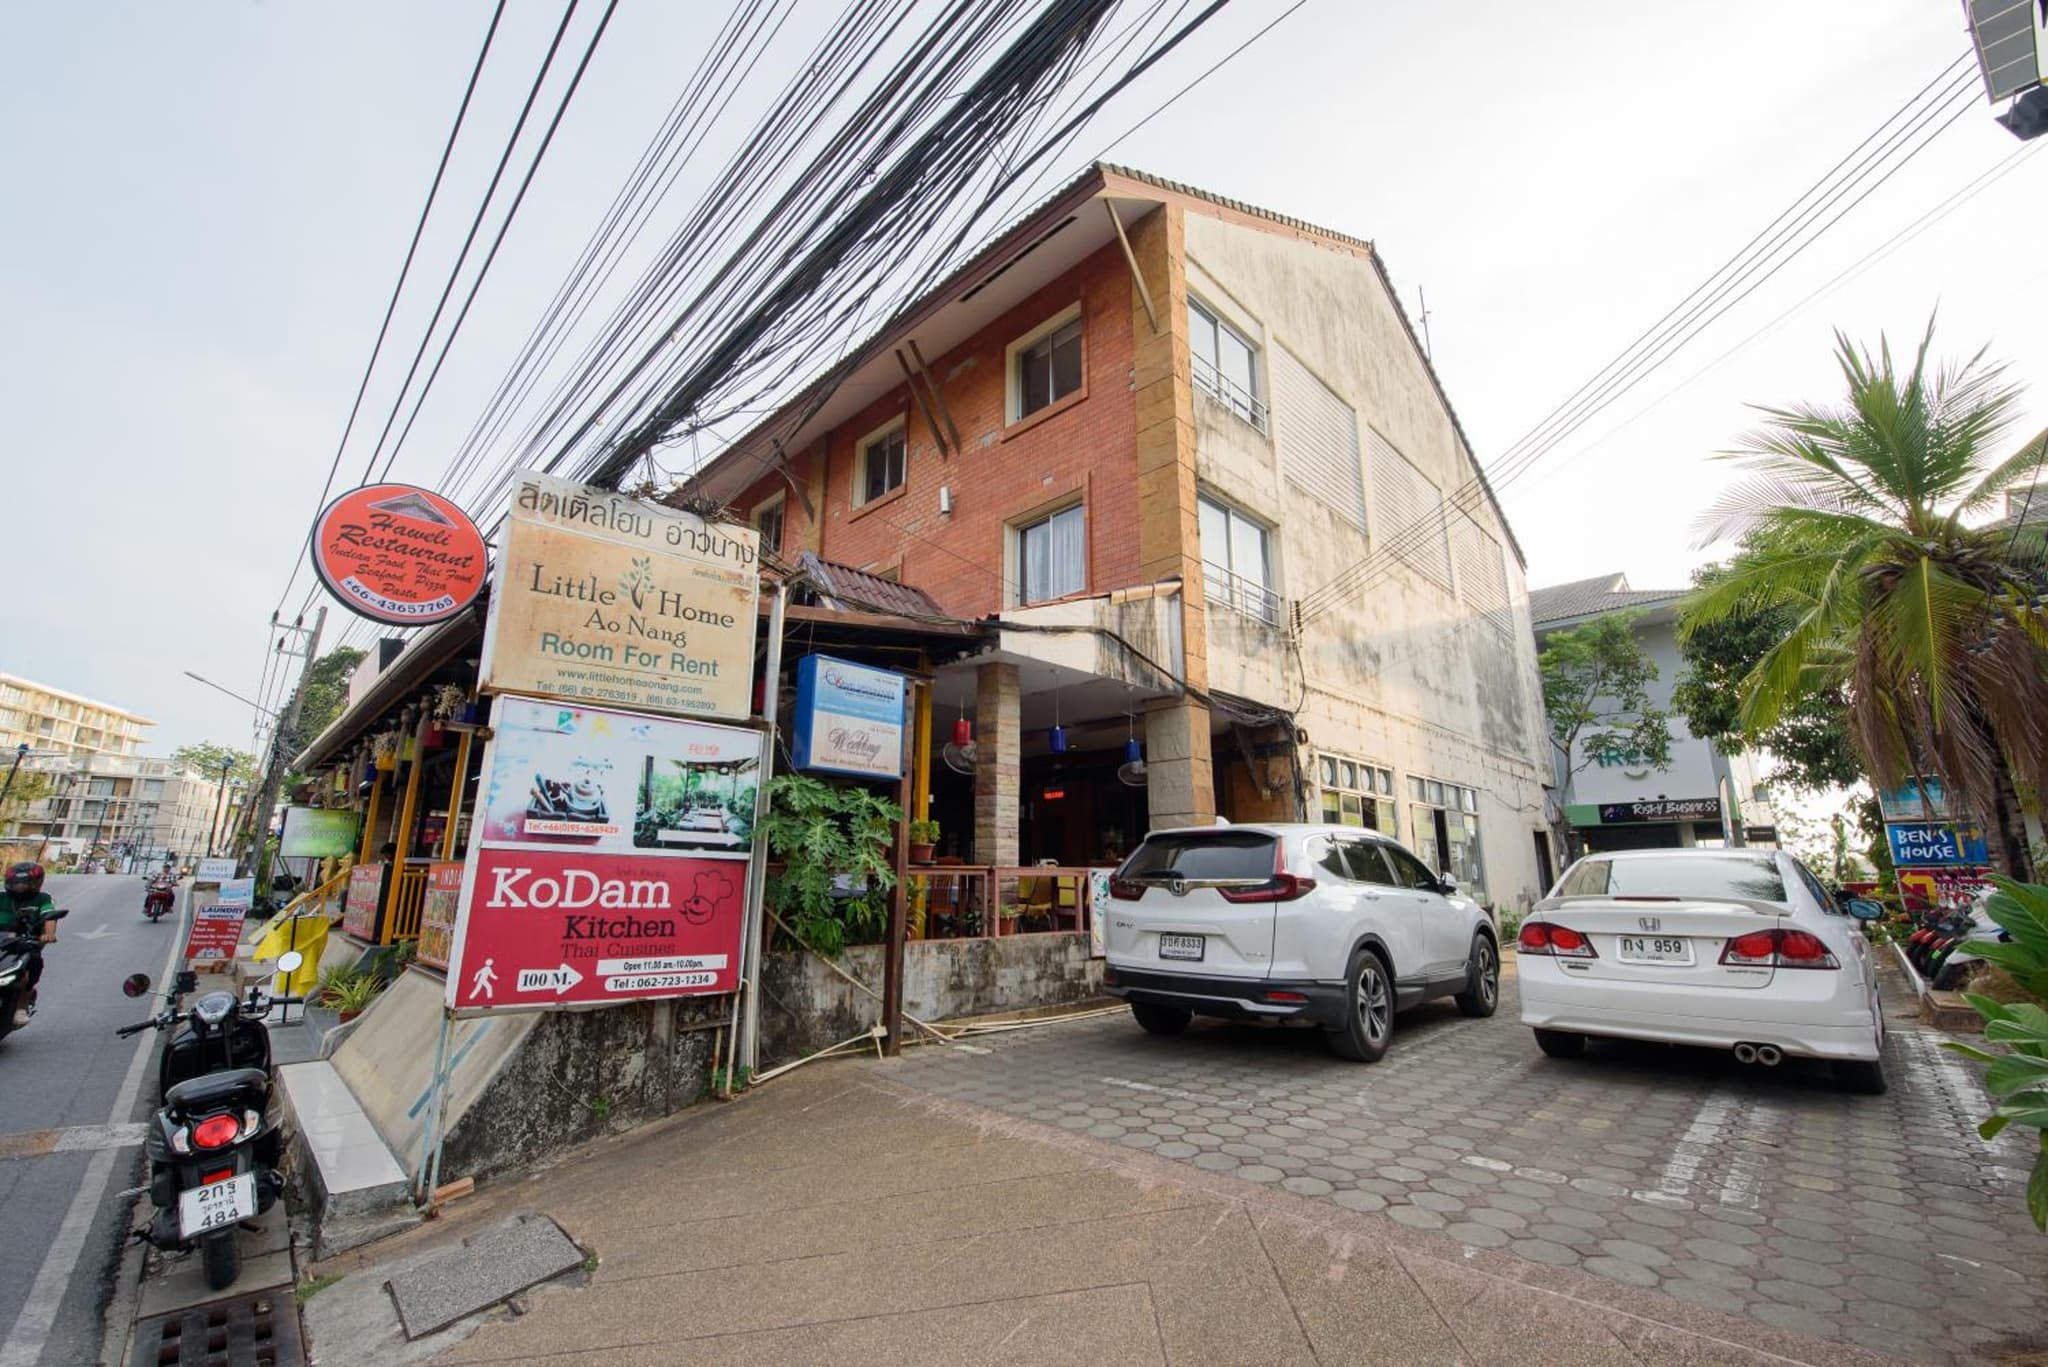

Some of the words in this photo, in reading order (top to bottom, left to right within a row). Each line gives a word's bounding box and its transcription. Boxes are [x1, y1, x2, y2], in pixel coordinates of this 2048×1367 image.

[369, 513, 452, 546] Haweli
[336, 524, 474, 568] Restaurant
[330, 544, 371, 562] Indian
[375, 554, 406, 570] Food
[415, 561, 441, 577] Thai
[446, 570, 475, 584] Food
[355, 563, 405, 583] Seafood
[415, 575, 447, 592] Pizza
[382, 583, 417, 599] Pasta
[530, 563, 616, 606] Little
[657, 590, 735, 629] Home
[583, 609, 621, 633] Ao
[627, 615, 687, 649] Nang
[541, 632, 613, 662] Room
[624, 646, 661, 668] For
[671, 652, 719, 677] Rent
[557, 669, 703, 694] www.littlehomeaonang.com
[1900, 845, 1955, 859] HOUSE
[486, 867, 671, 909] KoDam
[202, 906, 243, 914] LAUNDRY
[562, 915, 676, 940] Kitchen
[561, 943, 600, 959] Thai
[607, 941, 676, 958] Cuisines
[1654, 940, 1682, 953] 959
[523, 973, 548, 988] 100
[551, 972, 573, 986] M.
[637, 974, 709, 988] 062-723-1234
[201, 1208, 239, 1227] 484
